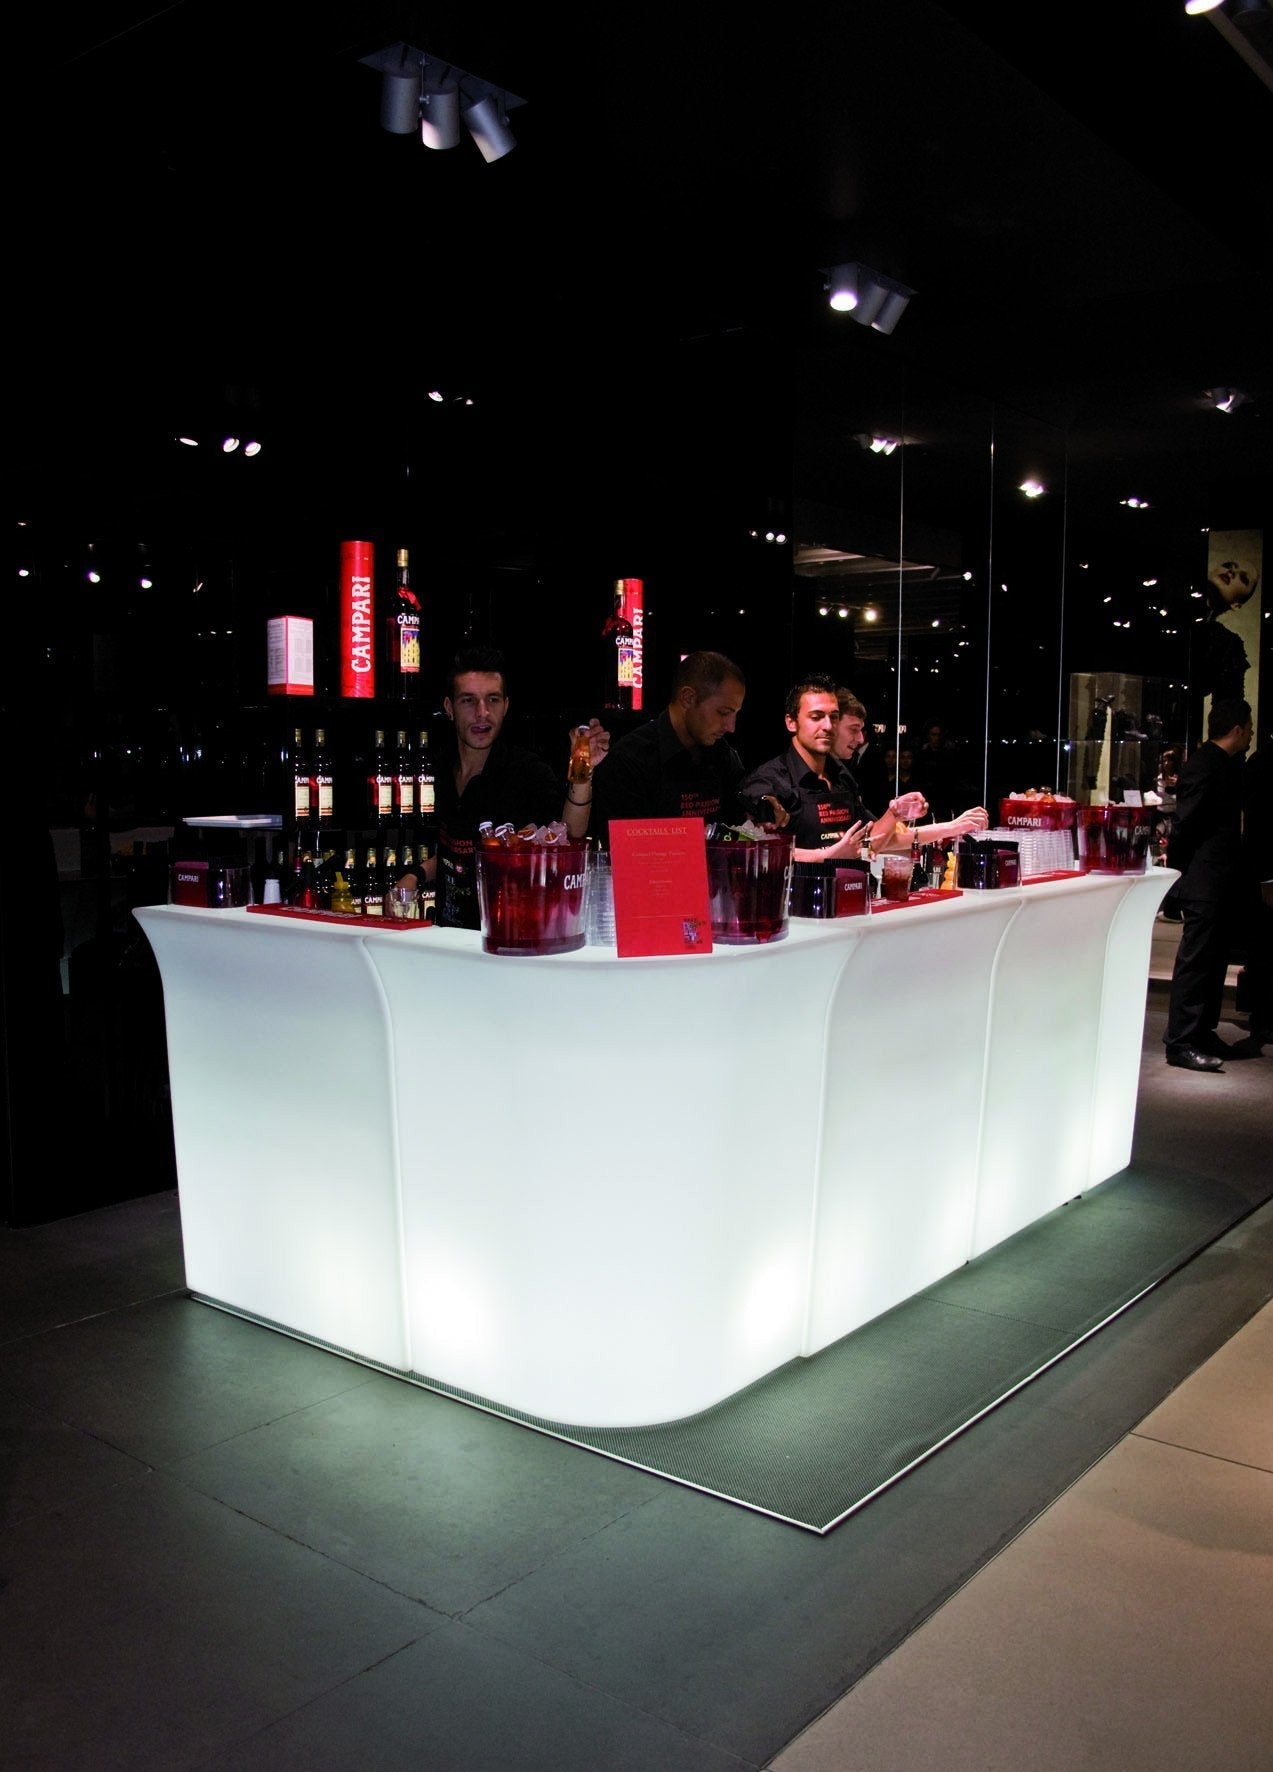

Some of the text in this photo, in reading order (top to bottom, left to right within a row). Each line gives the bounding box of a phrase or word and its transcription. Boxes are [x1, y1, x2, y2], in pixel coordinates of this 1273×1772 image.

[351, 576, 371, 673] CAMPARI
[1007, 816, 1042, 827] CAMPARI
[177, 874, 199, 882] CAMPARI
[844, 882, 863, 891] CAMPARI
